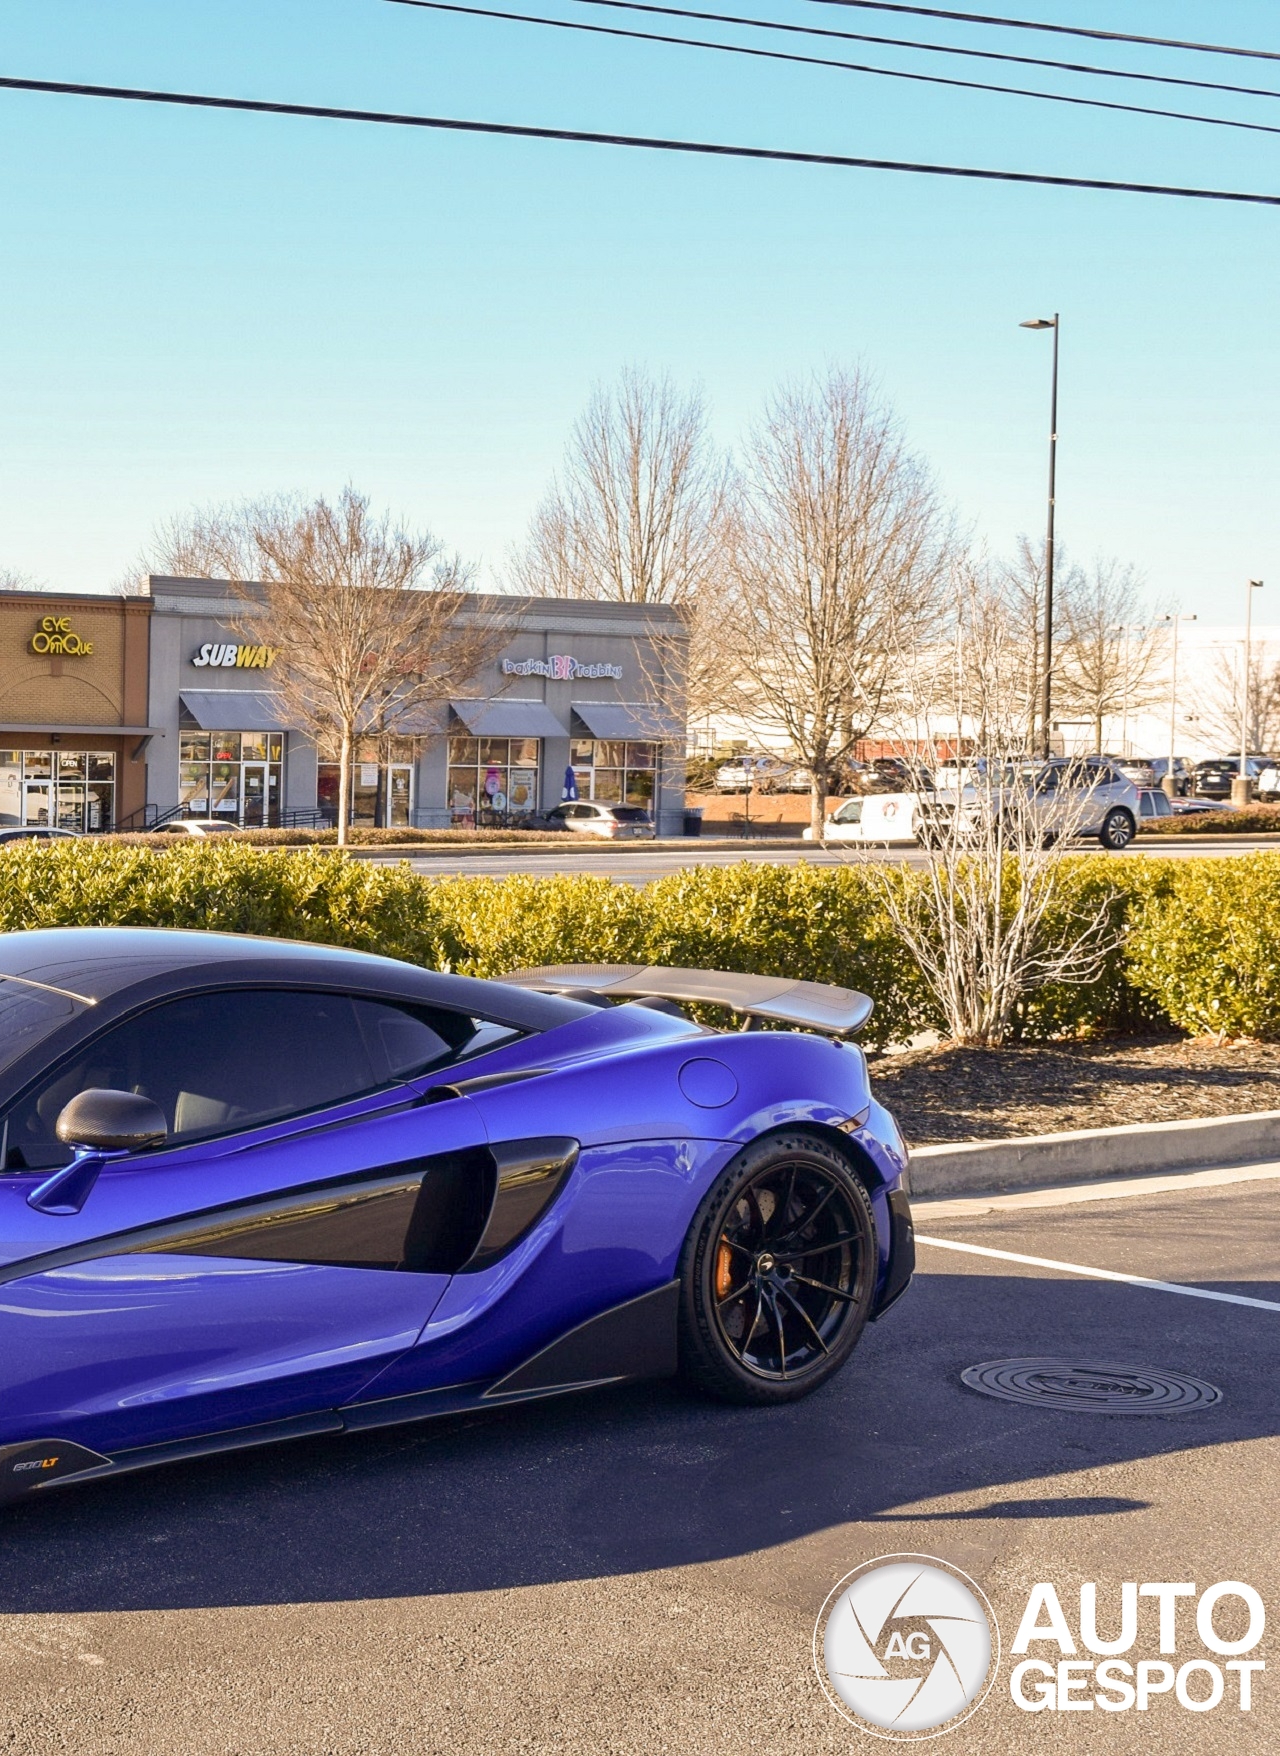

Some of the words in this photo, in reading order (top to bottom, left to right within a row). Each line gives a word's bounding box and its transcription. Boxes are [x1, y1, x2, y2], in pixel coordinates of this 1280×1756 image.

[42, 616, 72, 632] EYE
[193, 643, 281, 668] SUBWAY
[502, 658, 552, 678] baskin
[549, 655, 580, 680] BR
[577, 662, 623, 679] robbins
[61, 760, 78, 768] OPEN
[13, 1457, 59, 1471] 600LT
